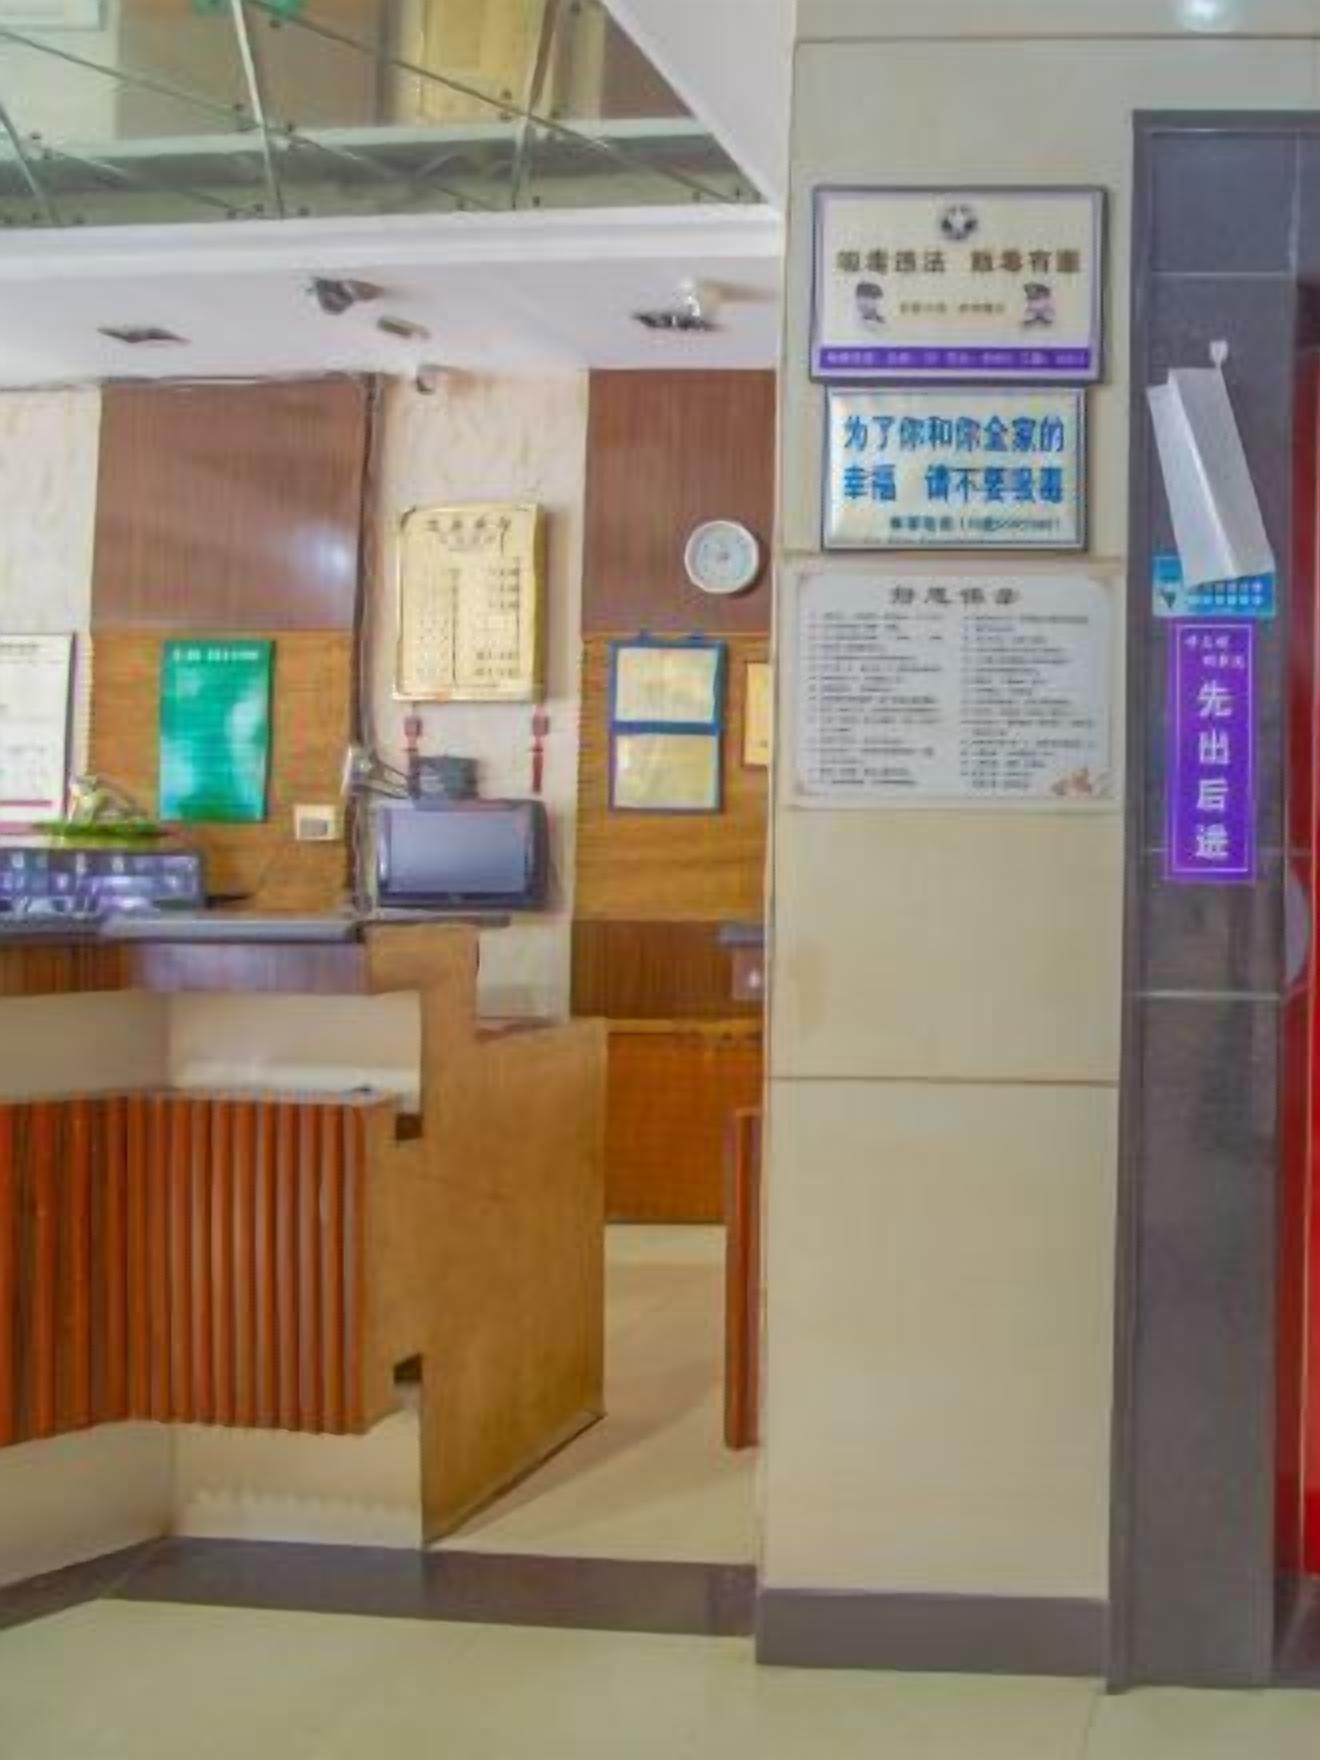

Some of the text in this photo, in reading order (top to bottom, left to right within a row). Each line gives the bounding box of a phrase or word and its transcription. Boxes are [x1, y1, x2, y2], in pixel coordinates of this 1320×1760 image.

[843, 415, 1065, 453] 为了你和你全家的
[843, 463, 897, 502] 幸福
[1196, 679, 1233, 860] 先出后进
